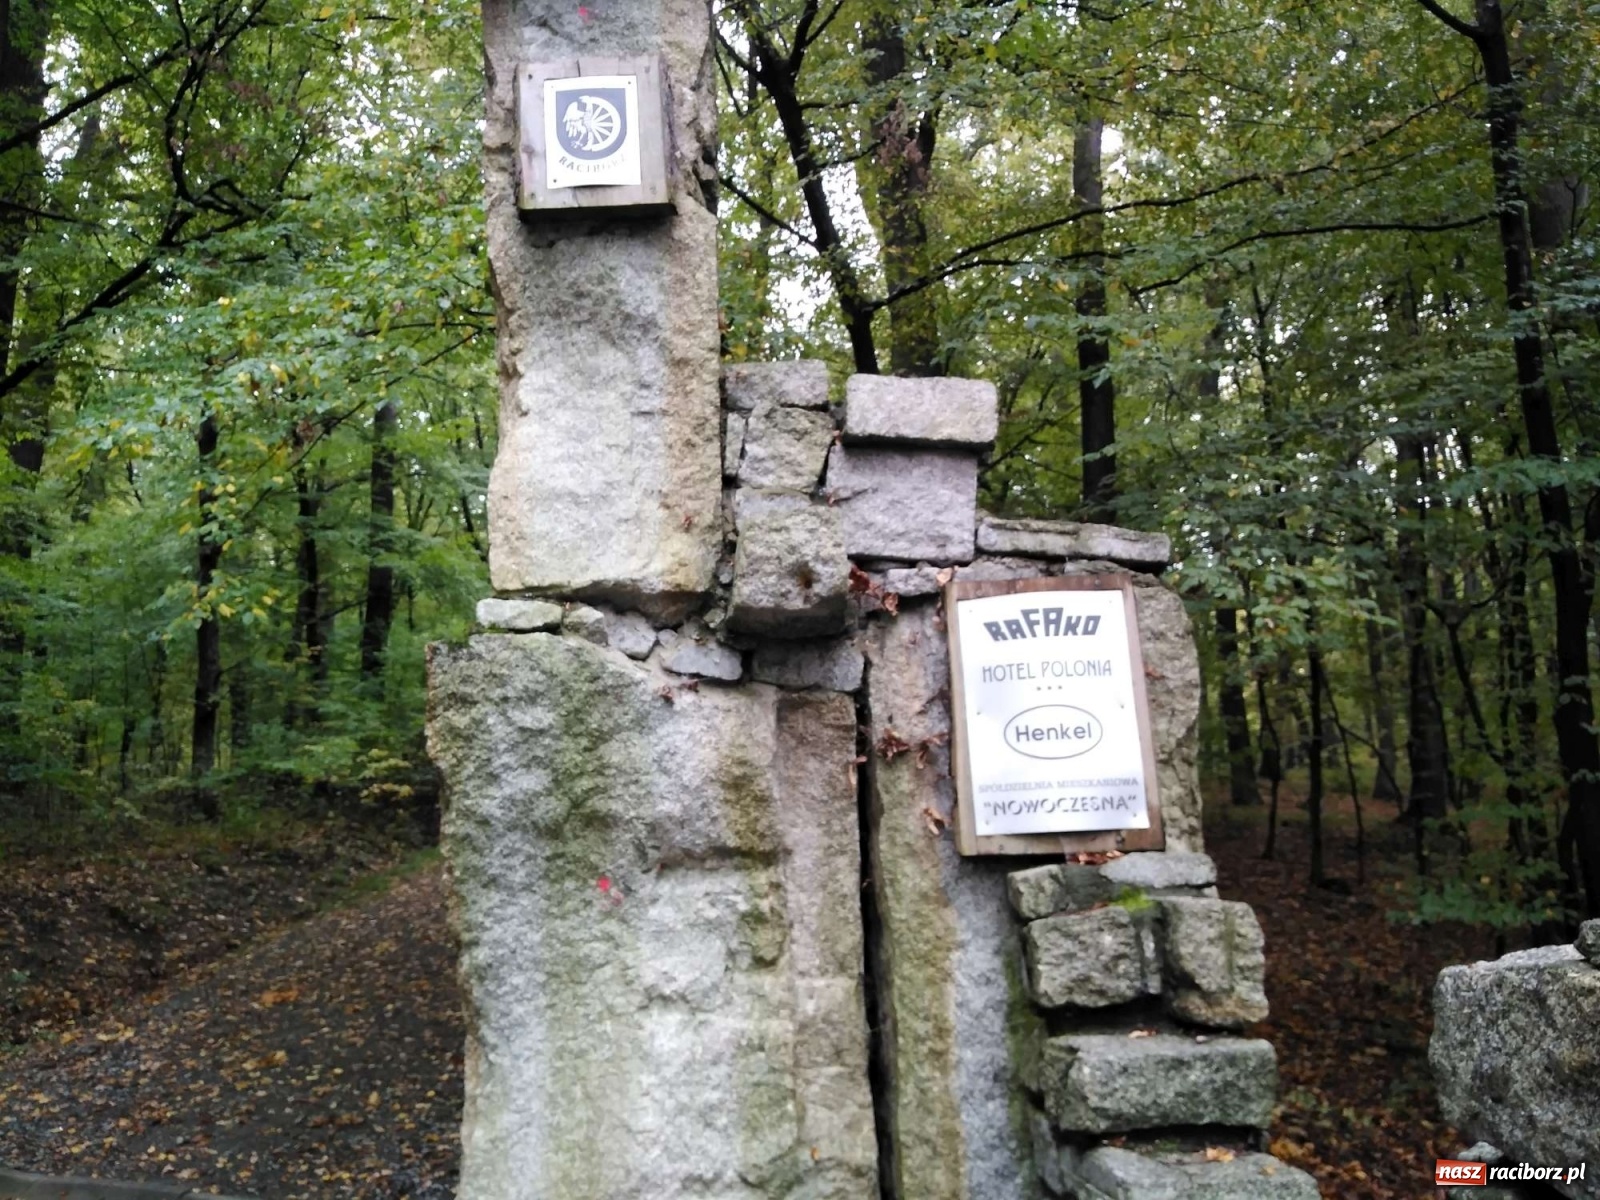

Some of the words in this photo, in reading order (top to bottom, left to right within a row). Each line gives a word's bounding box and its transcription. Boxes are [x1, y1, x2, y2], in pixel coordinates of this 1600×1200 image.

[983, 607, 1101, 641] RAFAKO
[982, 662, 1036, 683] HOTEL
[1041, 659, 1112, 678] POLONIA
[1015, 722, 1092, 742] Henkel
